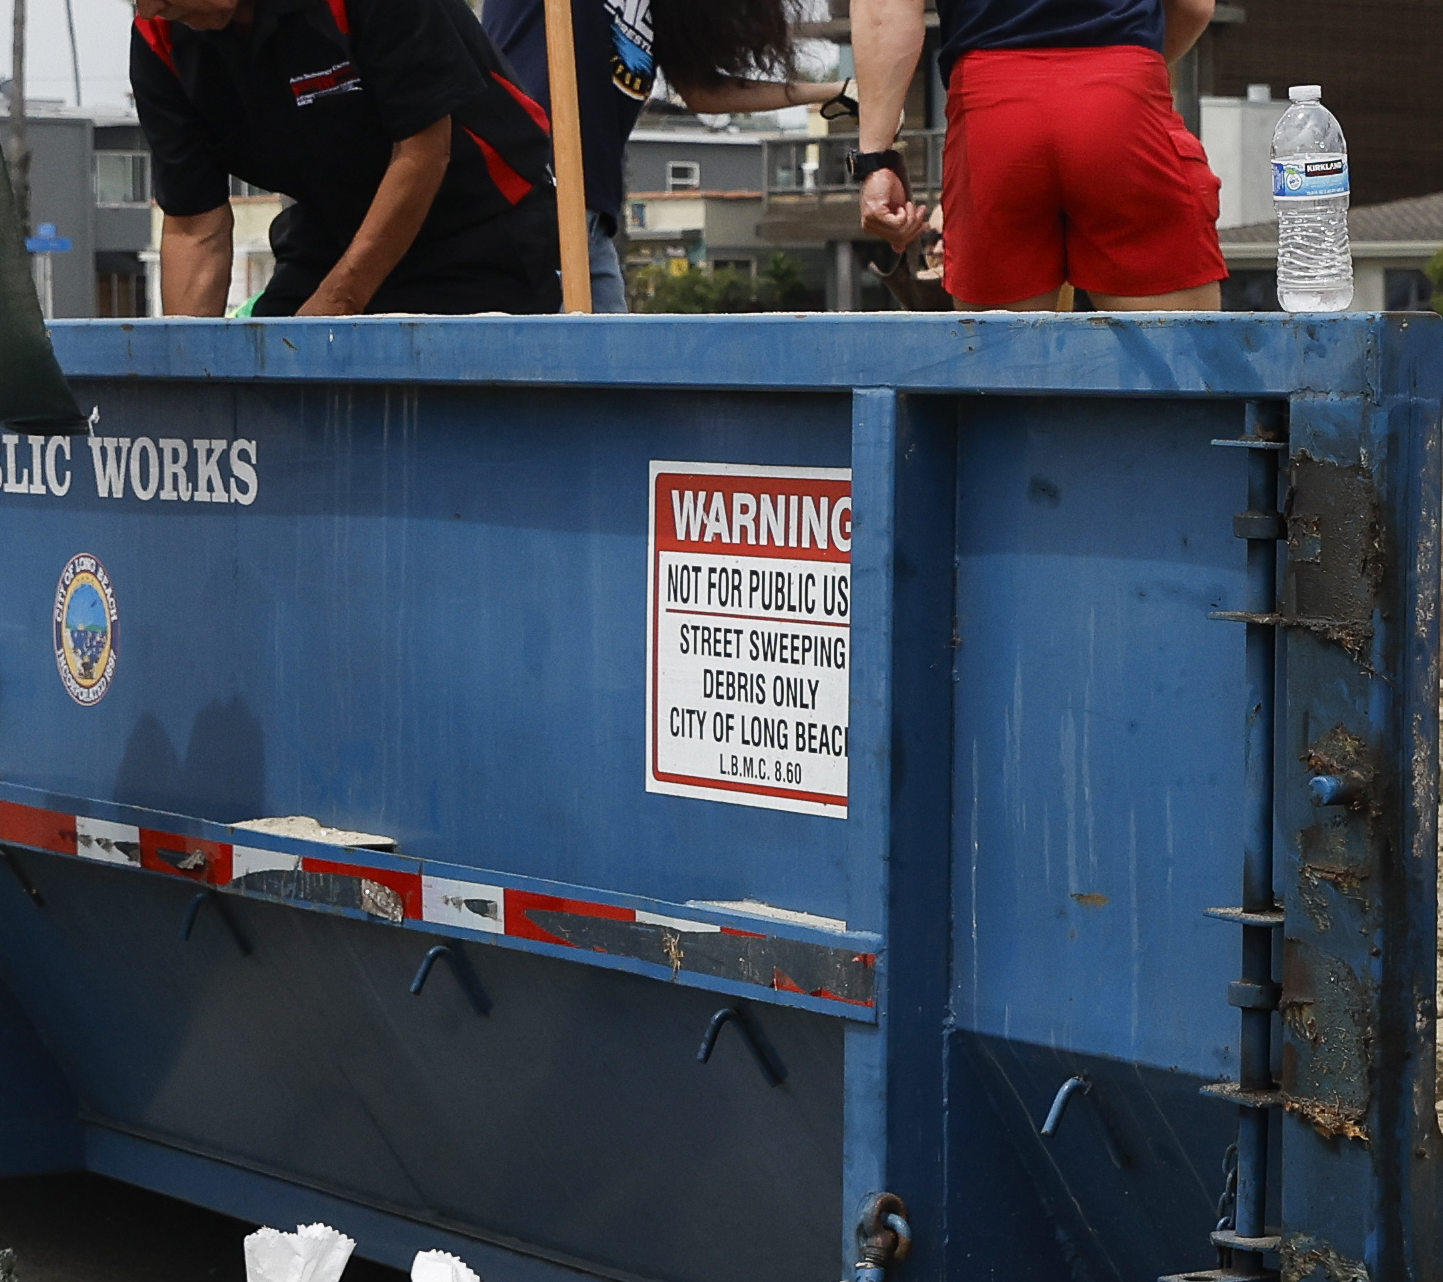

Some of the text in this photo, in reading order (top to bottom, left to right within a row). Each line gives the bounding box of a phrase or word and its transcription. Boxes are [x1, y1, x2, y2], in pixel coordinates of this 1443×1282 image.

[1306, 161, 1342, 172] KIRKLAND
[88, 437, 258, 506] WORKS
[671, 489, 852, 552] WARNING
[64, 563, 75, 585] OF
[75, 556, 97, 573] LONG
[97, 567, 118, 622] BEACH
[667, 564, 849, 617] NOT FOR PUBLIC US
[680, 623, 846, 670] STREET SWEEPING
[703, 668, 820, 710] DEBRIS ONLY
[670, 706, 707, 740] CITY
[713, 711, 735, 743] OF
[741, 715, 789, 751] LONG
[719, 753, 802, 784] L.B.M.C. 8.60
